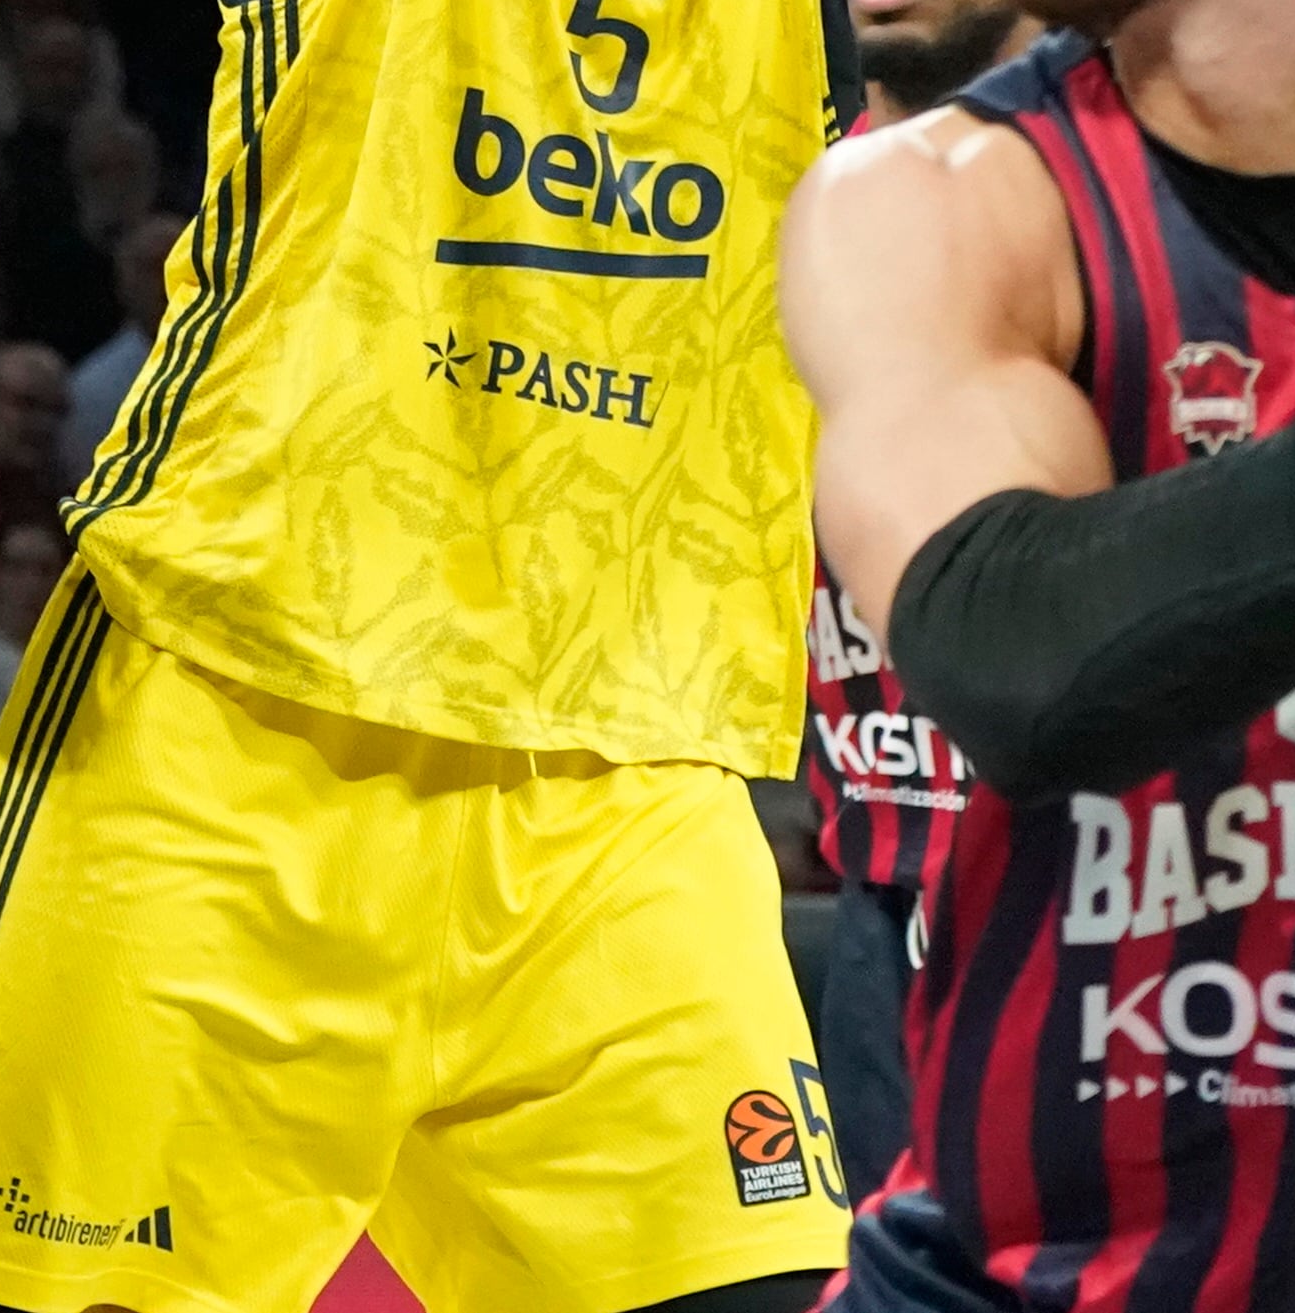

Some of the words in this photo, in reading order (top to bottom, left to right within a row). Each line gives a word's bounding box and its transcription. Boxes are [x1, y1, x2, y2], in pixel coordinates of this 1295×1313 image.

[452, 87, 725, 243] beko
[739, 1160, 802, 1180] TURKISH
[788, 1057, 851, 1211] 5
[744, 1172, 805, 1192] AIRLINES
